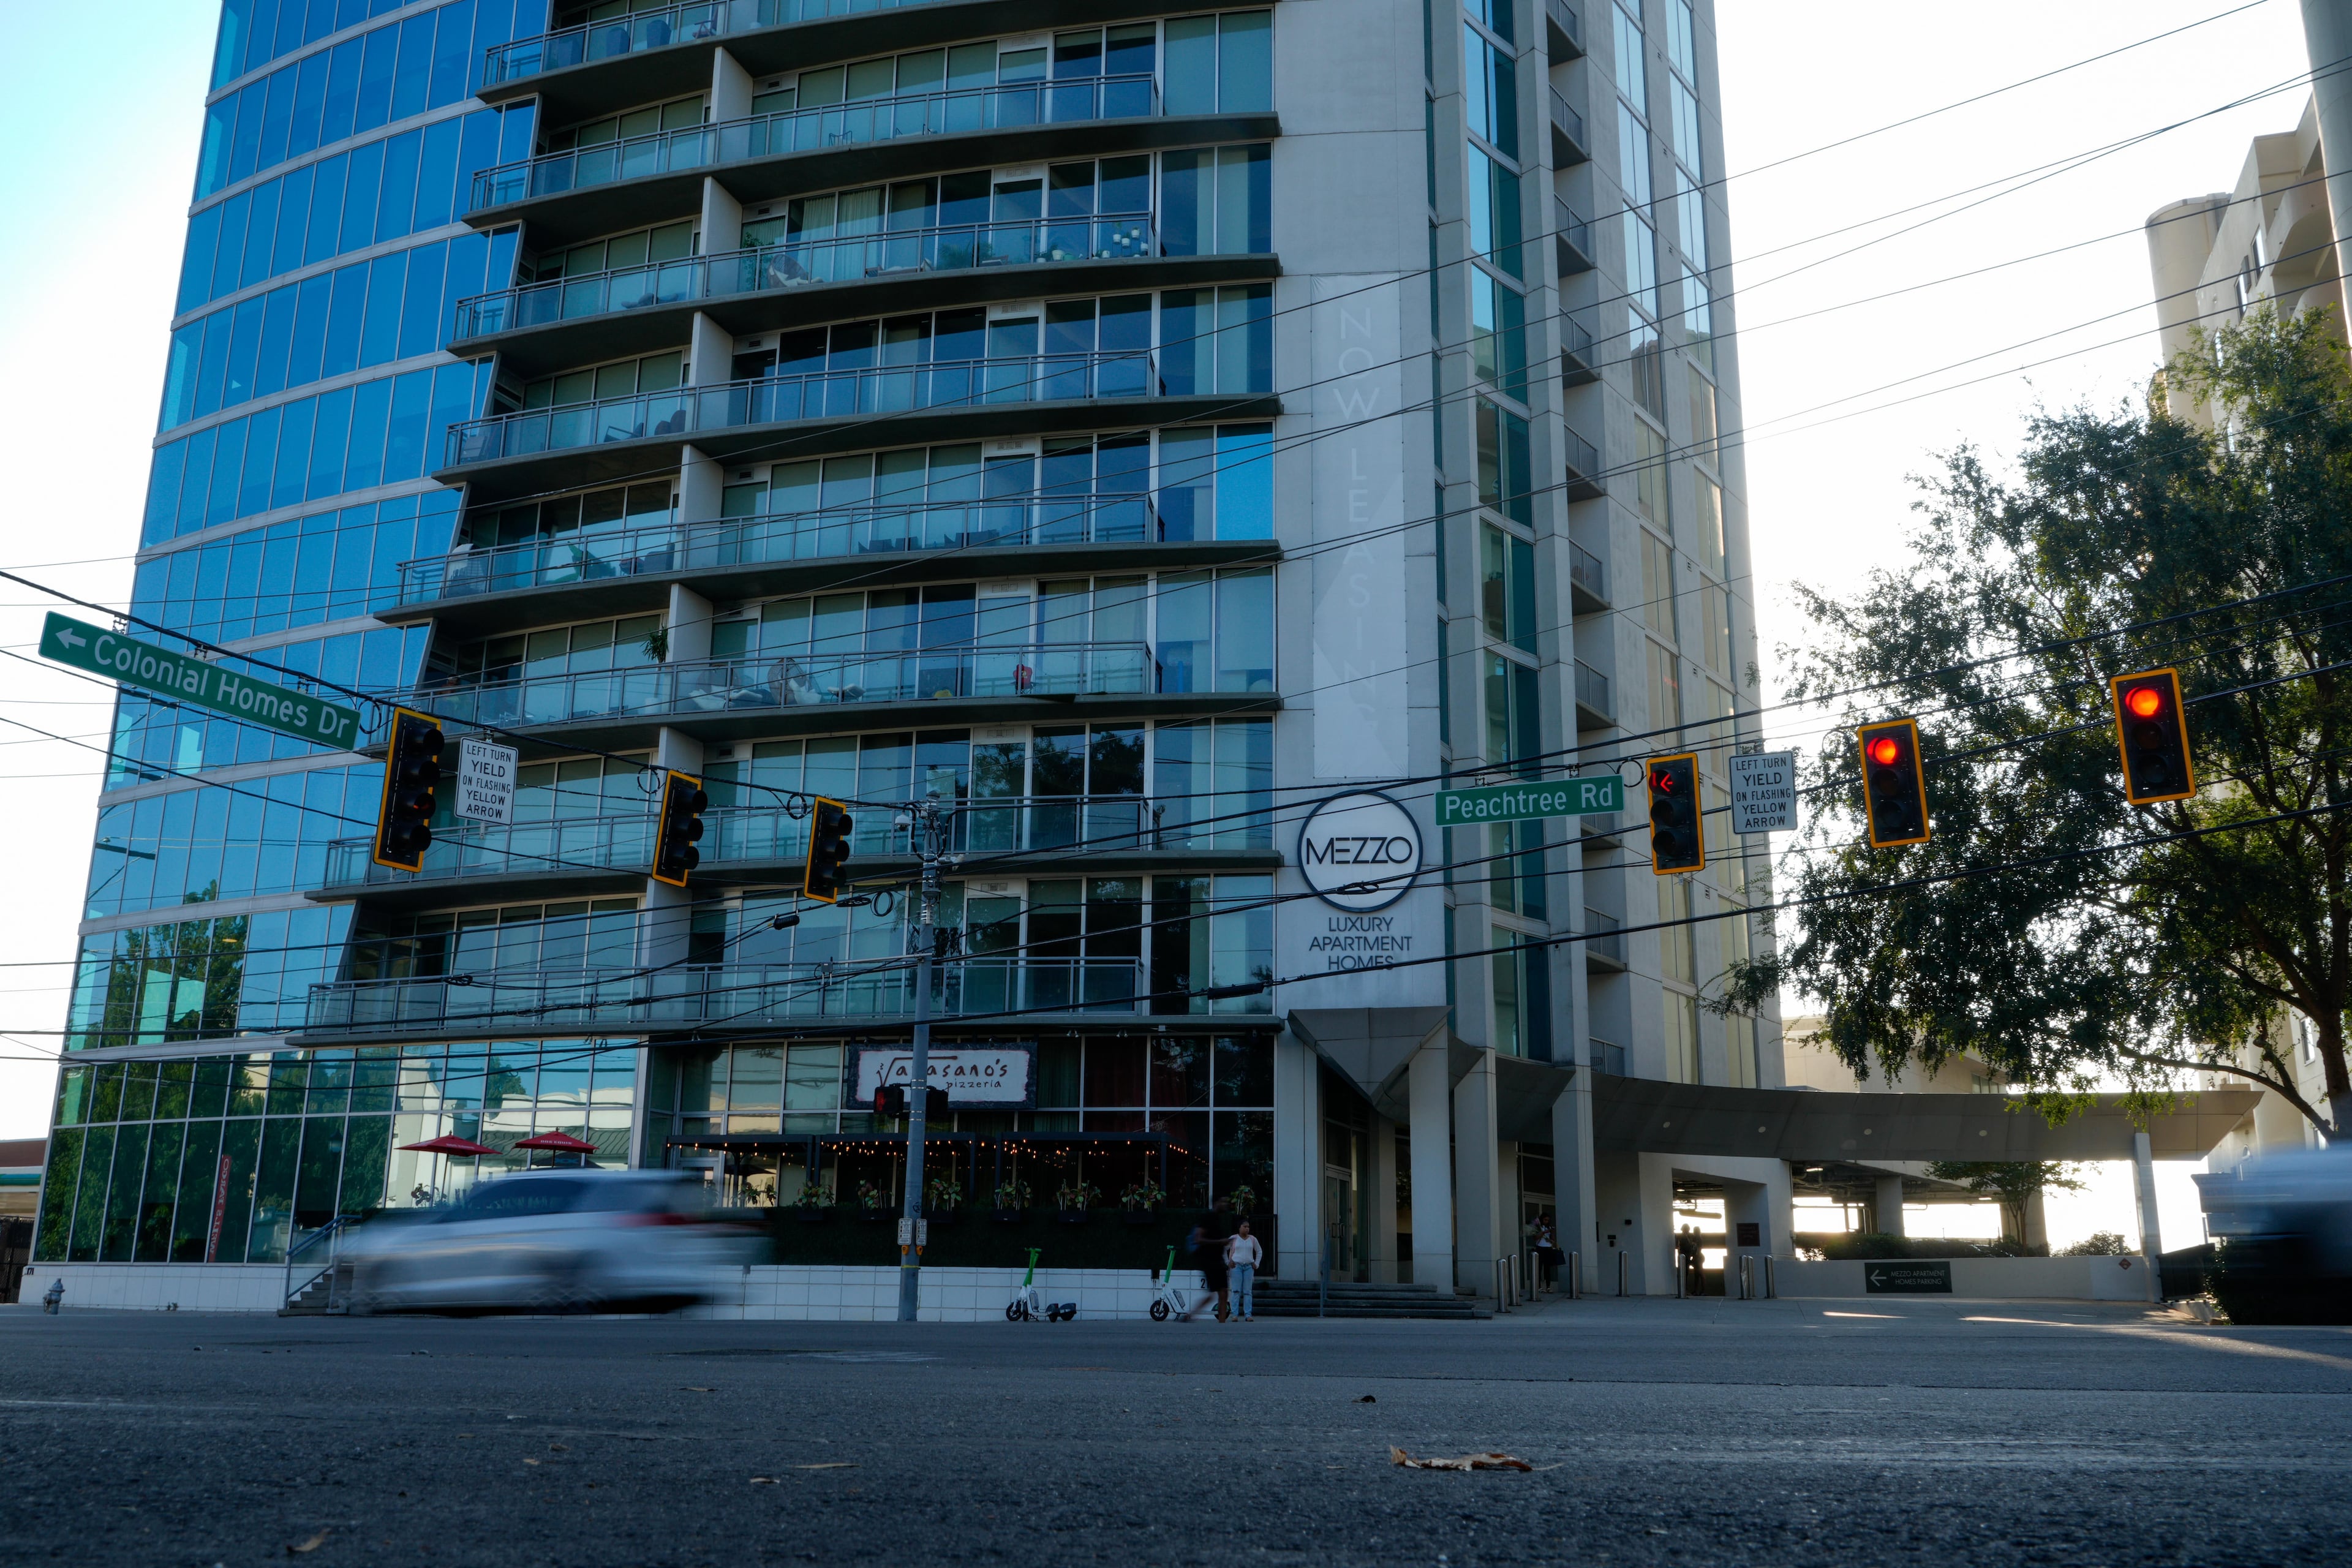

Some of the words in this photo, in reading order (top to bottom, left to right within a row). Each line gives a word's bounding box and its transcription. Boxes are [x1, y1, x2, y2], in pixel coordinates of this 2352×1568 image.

[1332, 307, 1381, 420] NOW
[94, 635, 209, 696] Colonial
[216, 673, 308, 727] Homes
[318, 706, 350, 738] Dr
[467, 744, 487, 757] LEFT
[491, 749, 511, 763] TURN
[472, 760, 505, 777] YIELD
[1736, 760, 1758, 771] LEFT
[1762, 757, 1787, 769] TURN
[462, 775, 472, 786] ON
[477, 778, 511, 793] FLASHING
[1743, 772, 1782, 787] YIELD
[467, 789, 505, 806] YELLOW
[1446, 790, 1567, 820] Peachtree
[1581, 782, 1612, 809] Rd
[1736, 791, 1746, 802] ON
[1752, 788, 1790, 801] FLASHING
[466, 803, 503, 819] ARROW
[1742, 802, 1786, 815] YELLOW
[1745, 815, 1785, 829] ARROW
[1306, 836, 1412, 864] MEZZO
[1329, 917, 1393, 932] LUXURY
[1309, 936, 1412, 951] APARTMENT
[1329, 956, 1393, 970] HOMES
[876, 1056, 1008, 1087] Vaasano's
[946, 1079, 1001, 1090] pizzeria
